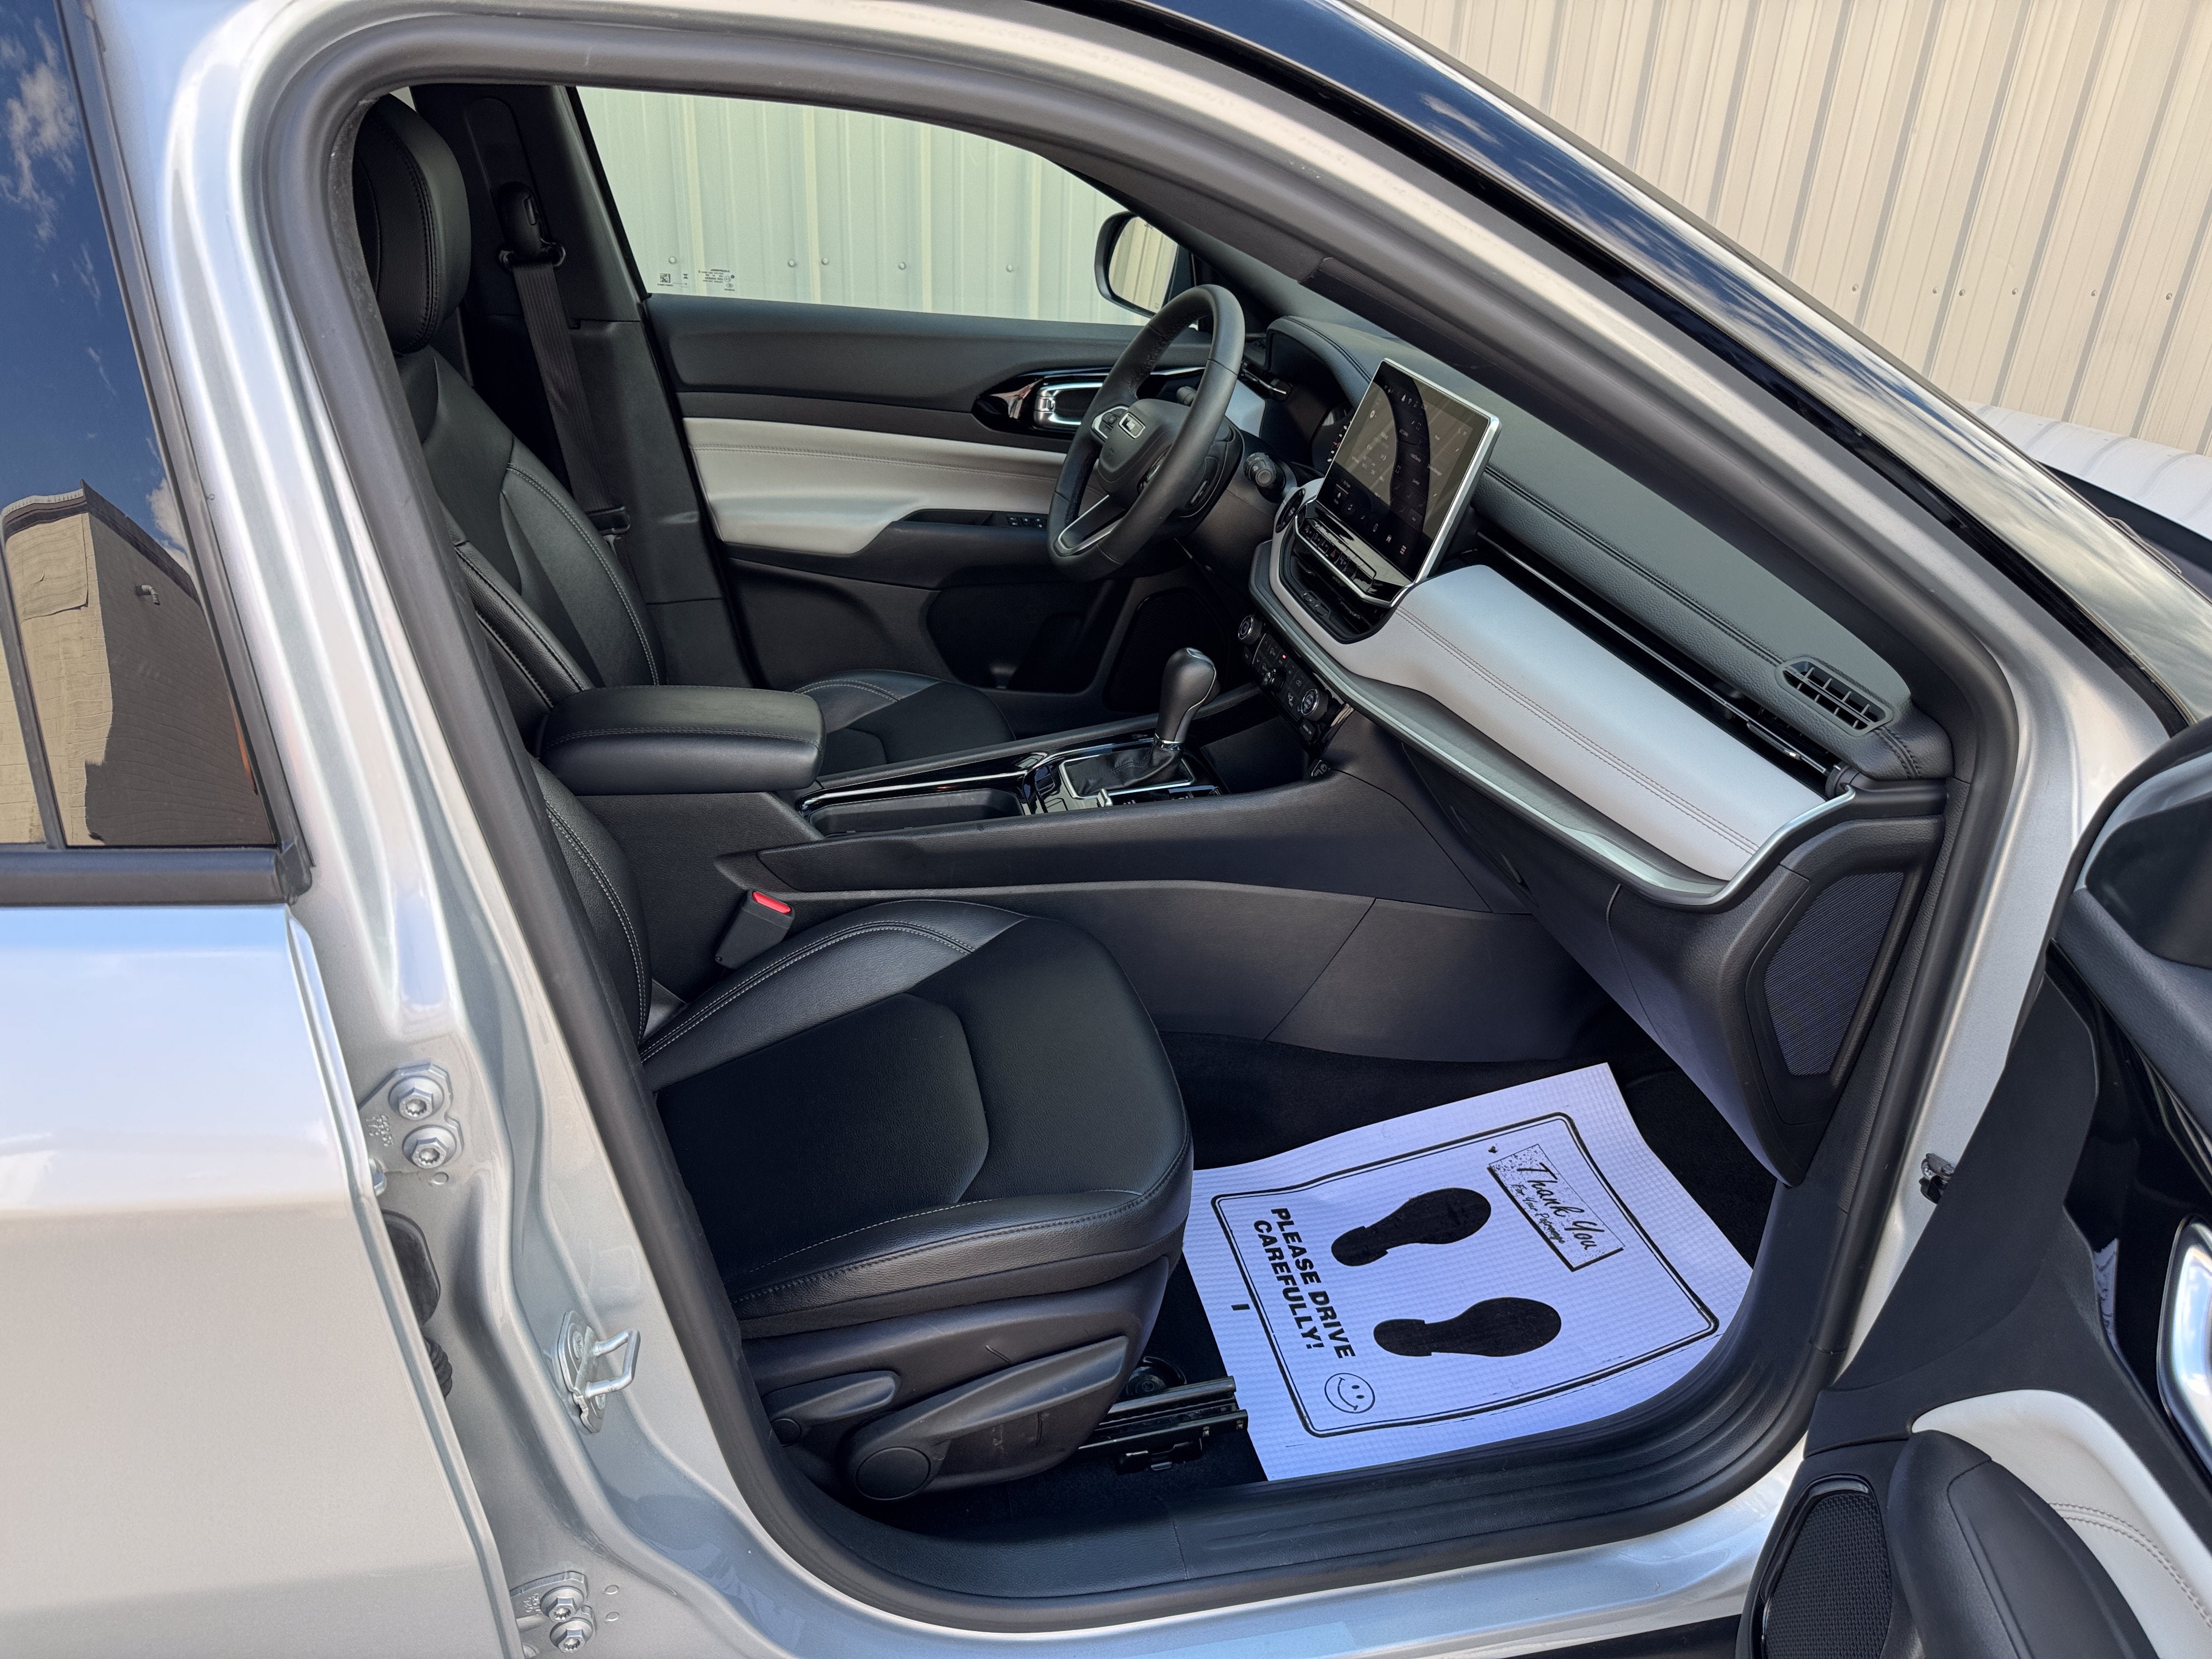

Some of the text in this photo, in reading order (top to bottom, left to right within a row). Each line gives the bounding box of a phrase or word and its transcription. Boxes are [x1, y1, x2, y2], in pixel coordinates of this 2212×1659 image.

[1511, 1183, 1528, 1196] For
[1522, 1197, 1538, 1212] Your
[1516, 1162, 1605, 1250] Thank You
[1253, 1220, 1325, 1350] CAREFULLY!
[1270, 1207, 1356, 1359] PLEASE DRIVE
